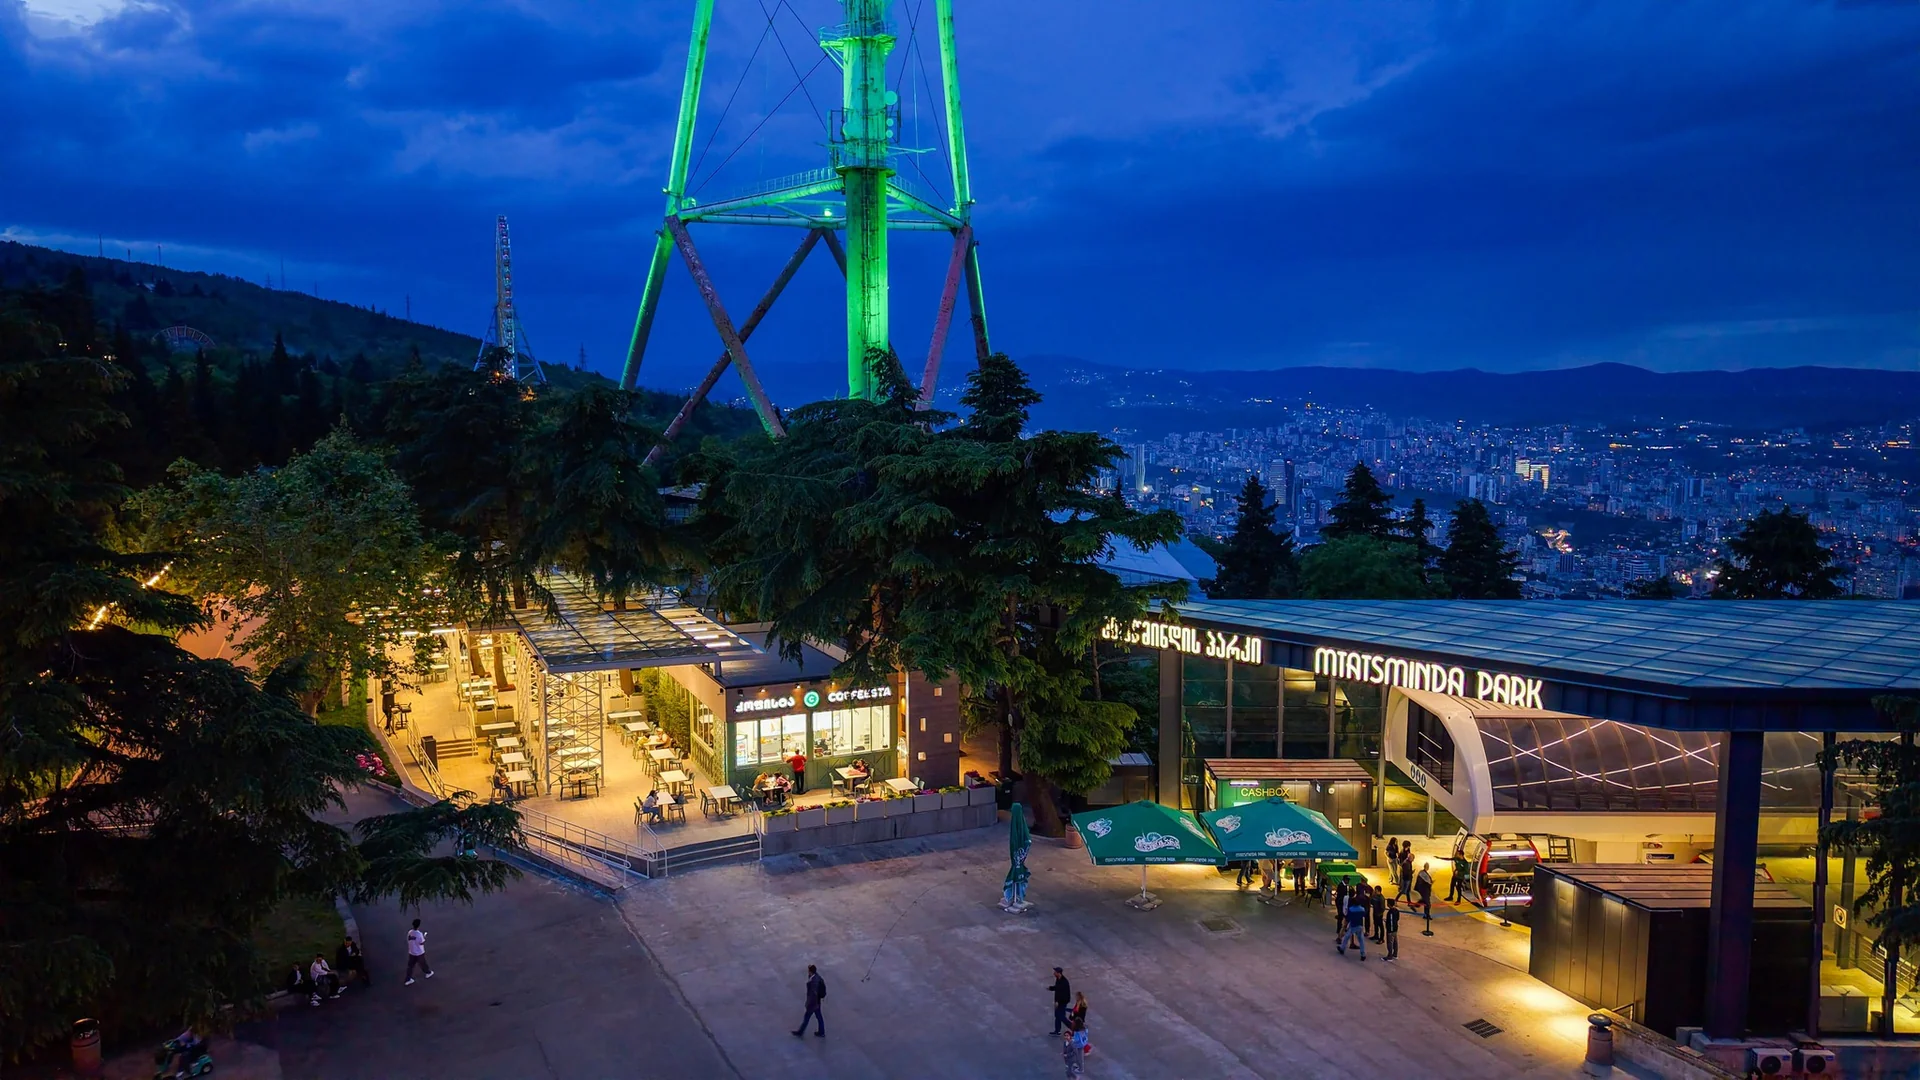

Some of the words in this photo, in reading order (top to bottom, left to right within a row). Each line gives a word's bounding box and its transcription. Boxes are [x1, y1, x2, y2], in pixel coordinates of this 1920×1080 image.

[1205, 629, 1262, 664] პარკი
[1314, 646, 1465, 697] MTATSMINDA
[1477, 670, 1544, 710] PARK
[1240, 787, 1290, 797] CASHBOX
[1492, 882, 1531, 895] Tbilisi
